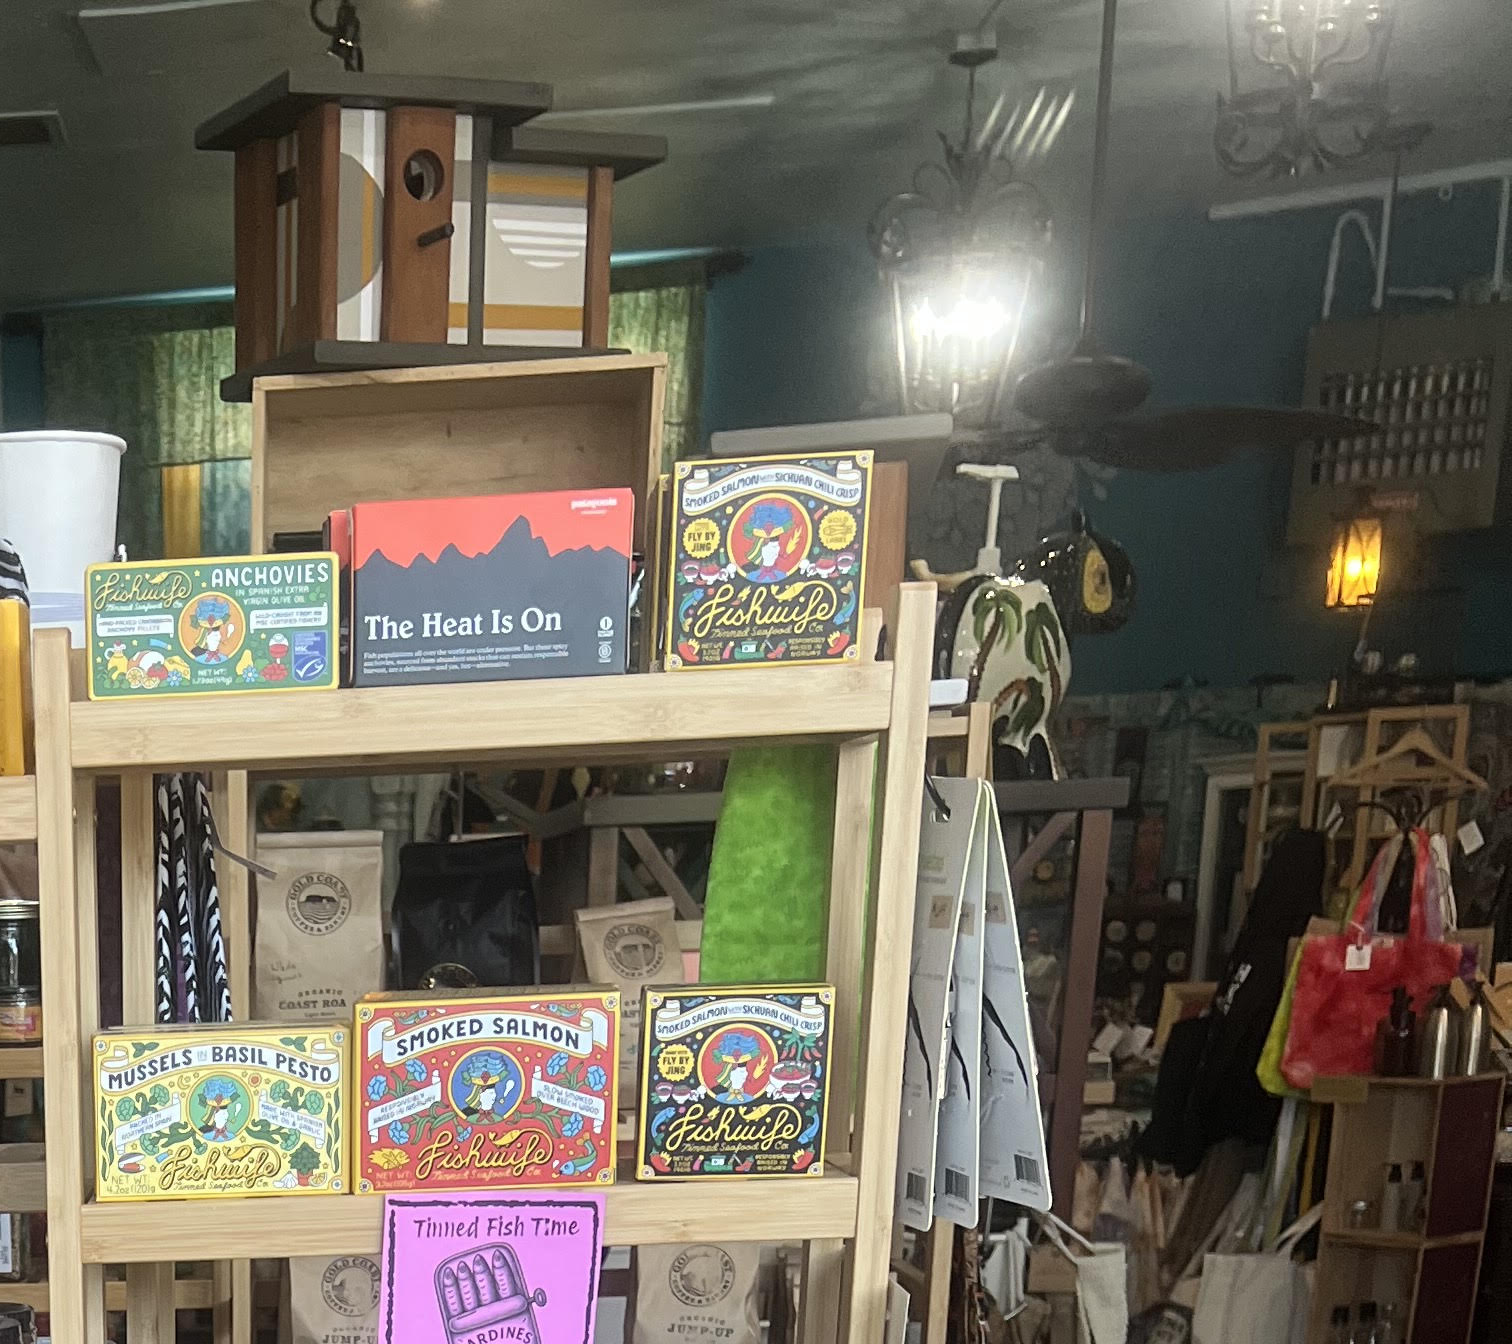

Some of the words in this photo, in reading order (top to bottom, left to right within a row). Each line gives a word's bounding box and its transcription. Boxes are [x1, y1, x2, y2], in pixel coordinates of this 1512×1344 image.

[94, 570, 192, 611] Fishwife
[210, 562, 330, 588] ANCHOVIES
[364, 613, 414, 641] The
[422, 611, 484, 638] Heat
[491, 609, 514, 635] Is
[520, 606, 563, 634] On
[694, 581, 838, 638] Fishwife
[397, 1018, 484, 1057] SMOKED
[493, 1017, 580, 1050] SALMON
[108, 1048, 193, 1090] MUSSELS
[211, 1046, 268, 1067] BASIL
[276, 1052, 333, 1084] PESTO
[413, 1216, 479, 1239] Tinned
[486, 1215, 525, 1238] Fish
[531, 1216, 581, 1238] Time
